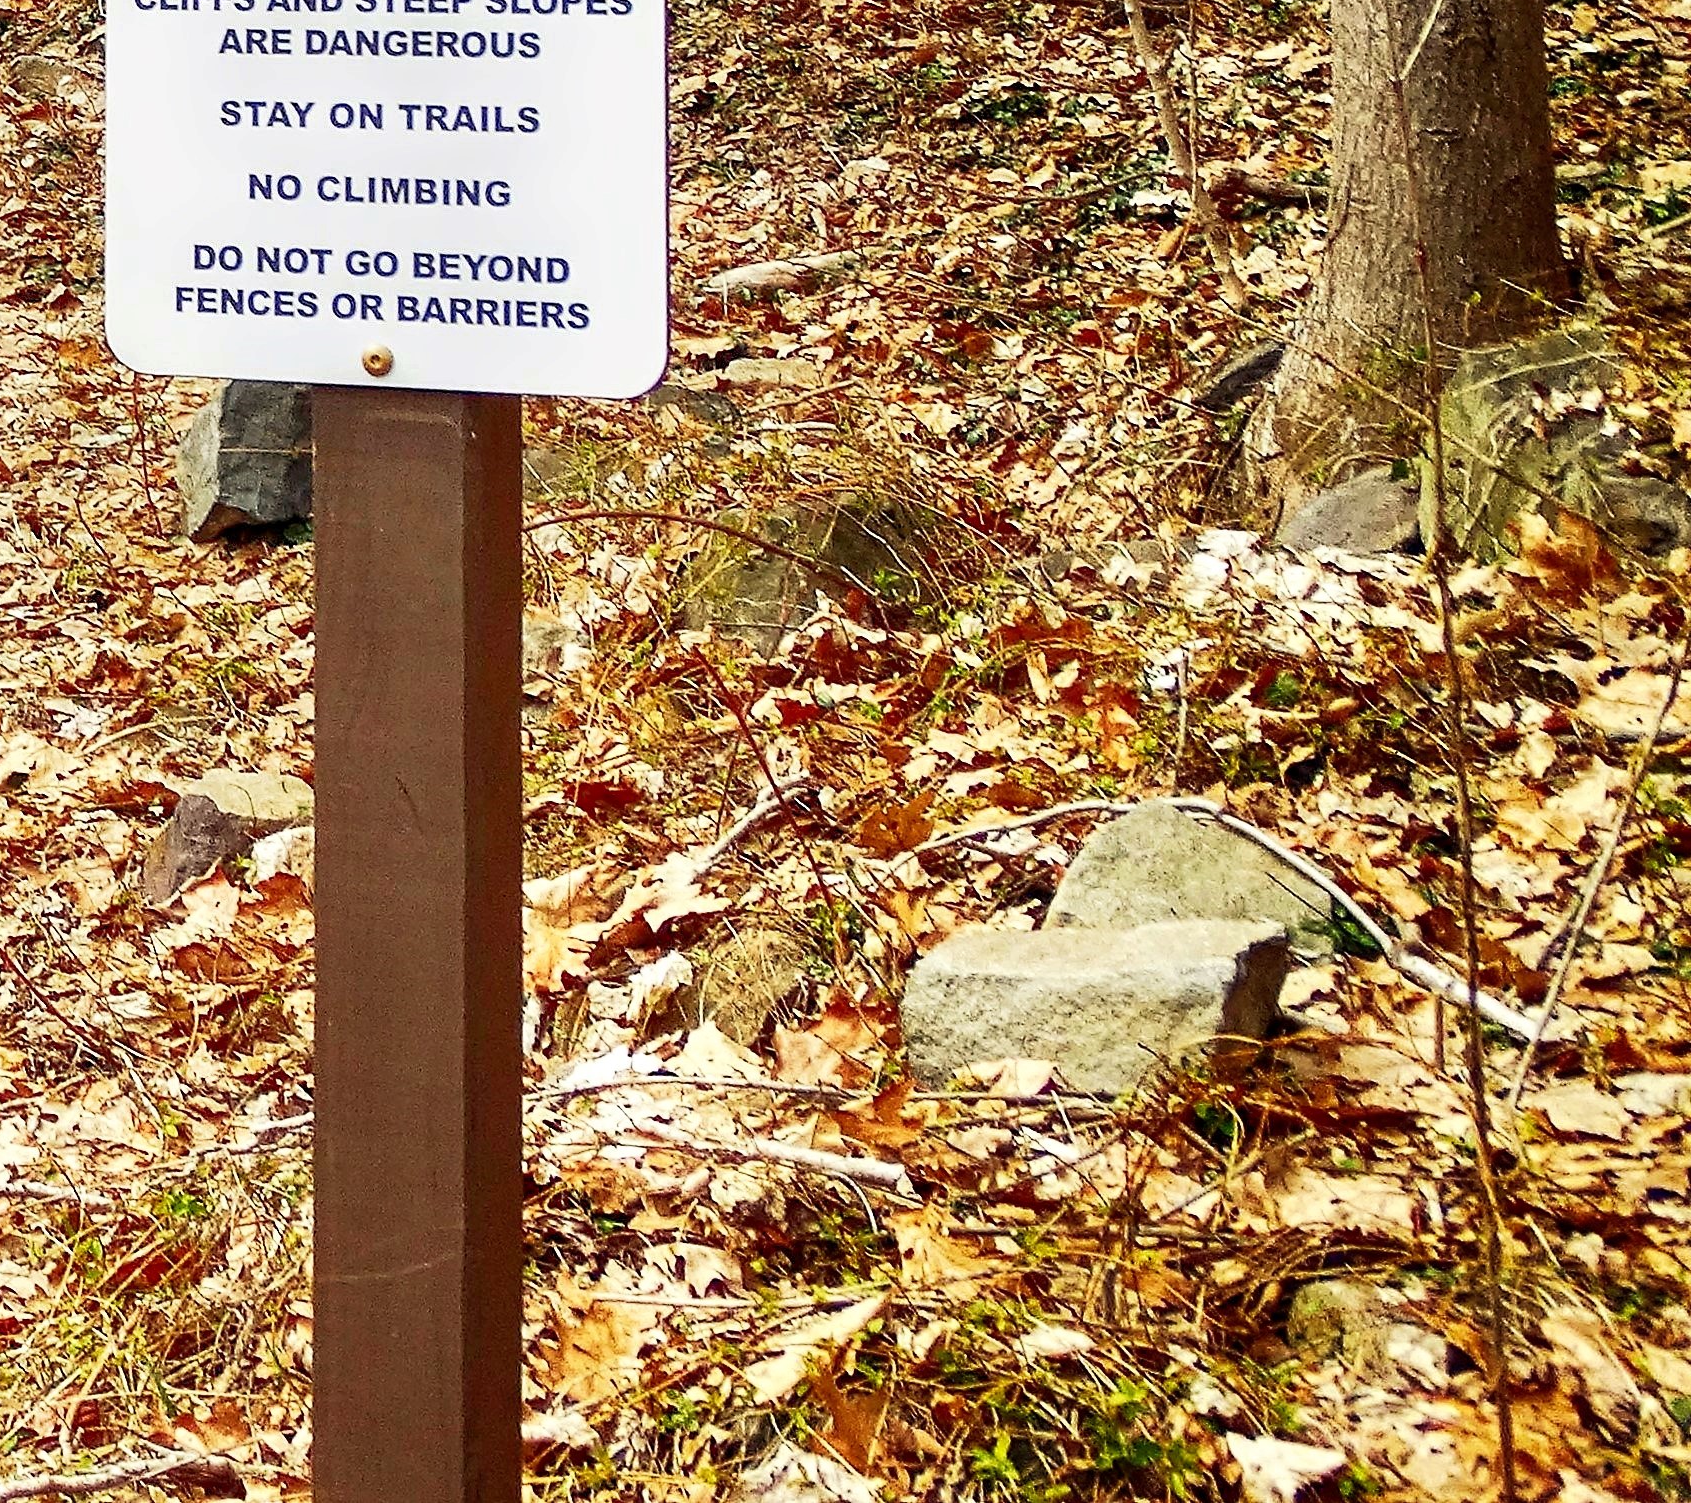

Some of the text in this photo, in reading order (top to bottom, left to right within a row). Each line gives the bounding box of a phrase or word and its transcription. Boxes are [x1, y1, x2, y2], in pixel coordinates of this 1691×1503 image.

[219, 29, 540, 58] ARE DANGEROUS
[221, 101, 539, 133] STAY ON TRAILS
[249, 174, 510, 207] NO CLIMBING
[194, 245, 569, 283] DO NOT GO BEYOND
[176, 287, 589, 329] FENCES OR BARRIERS
